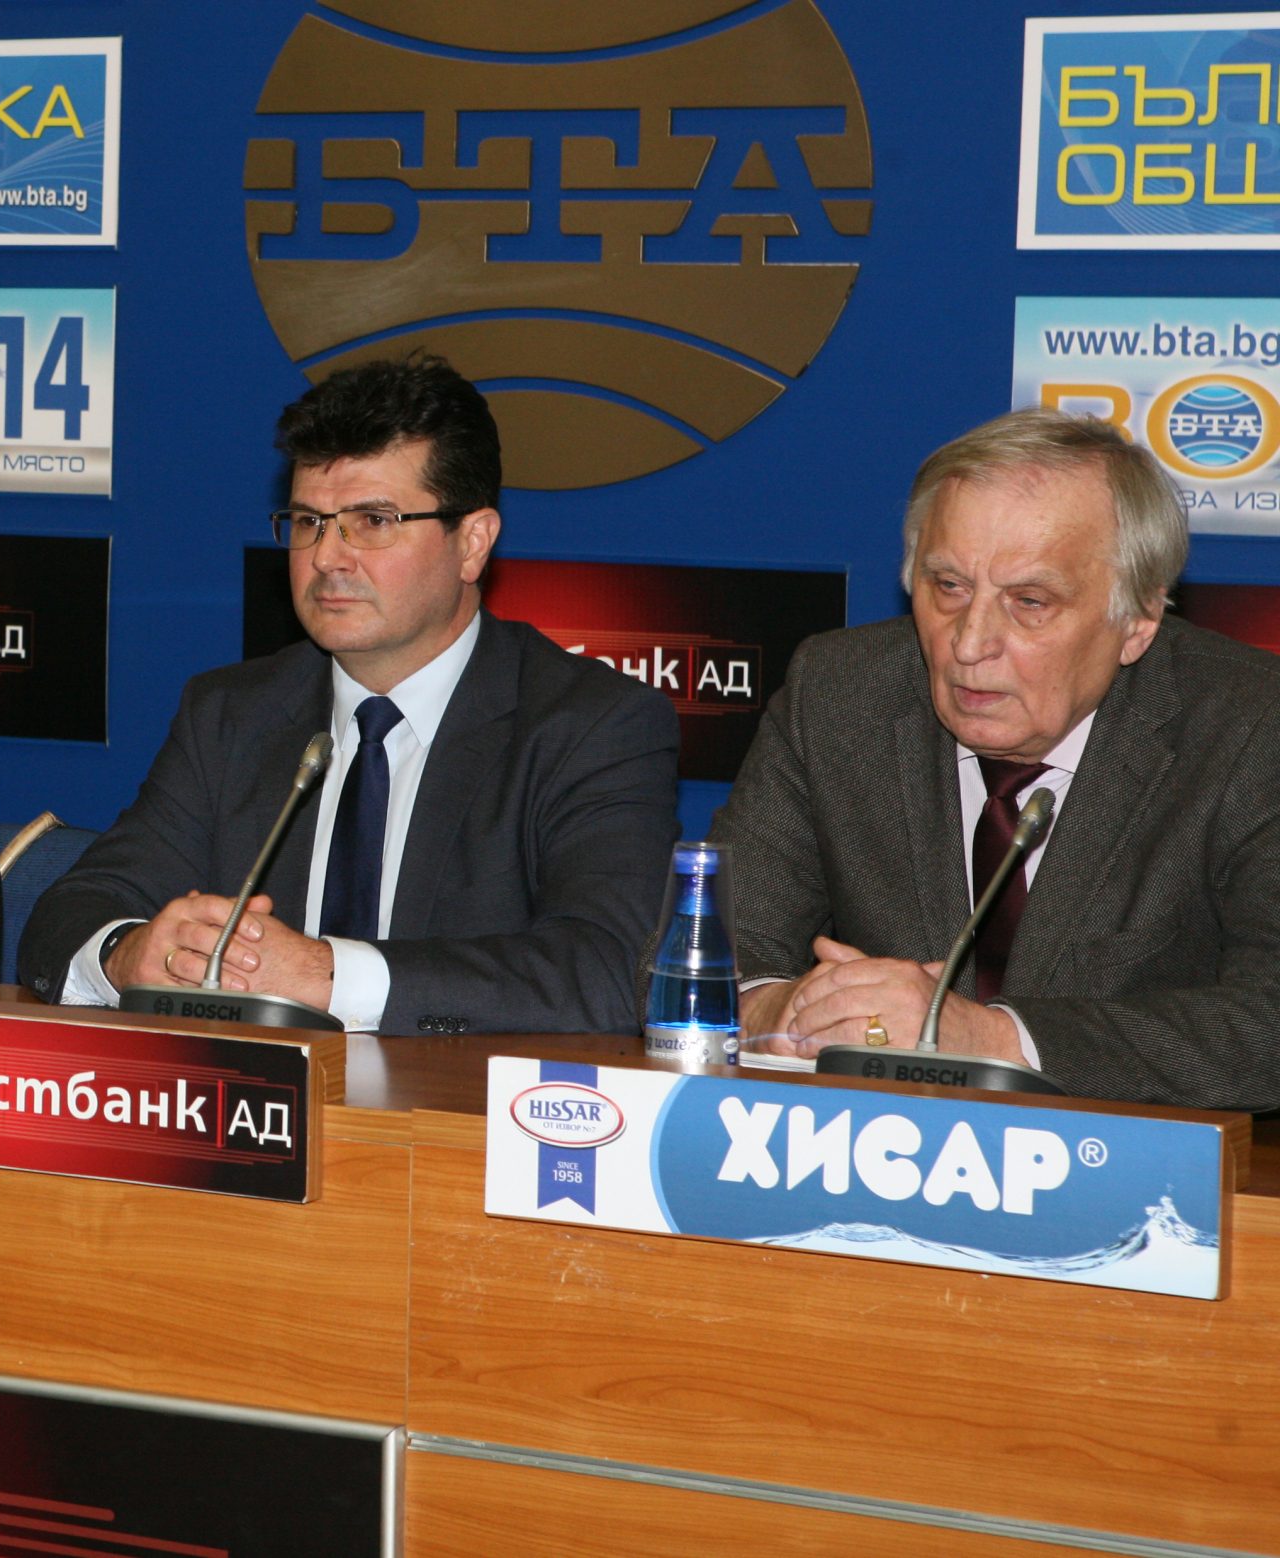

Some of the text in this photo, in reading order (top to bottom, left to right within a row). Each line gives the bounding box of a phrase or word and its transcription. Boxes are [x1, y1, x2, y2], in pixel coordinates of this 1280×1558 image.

[1058, 63, 1280, 127] БЪЛ
[256, 106, 860, 265] БТА
[1044, 323, 1280, 366] www.bta.bg
[1169, 413, 1263, 438] БТА
[3, 454, 86, 473] МЯСТО
[696, 659, 752, 698] АД
[180, 1001, 243, 1022] BOSCH
[894, 1064, 968, 1087] BOSCH
[529, 1099, 602, 1122] HISSAR
[227, 1098, 293, 1149] АД
[552, 1168, 583, 1184] 1958
[557, 1161, 579, 1171] SINCE
